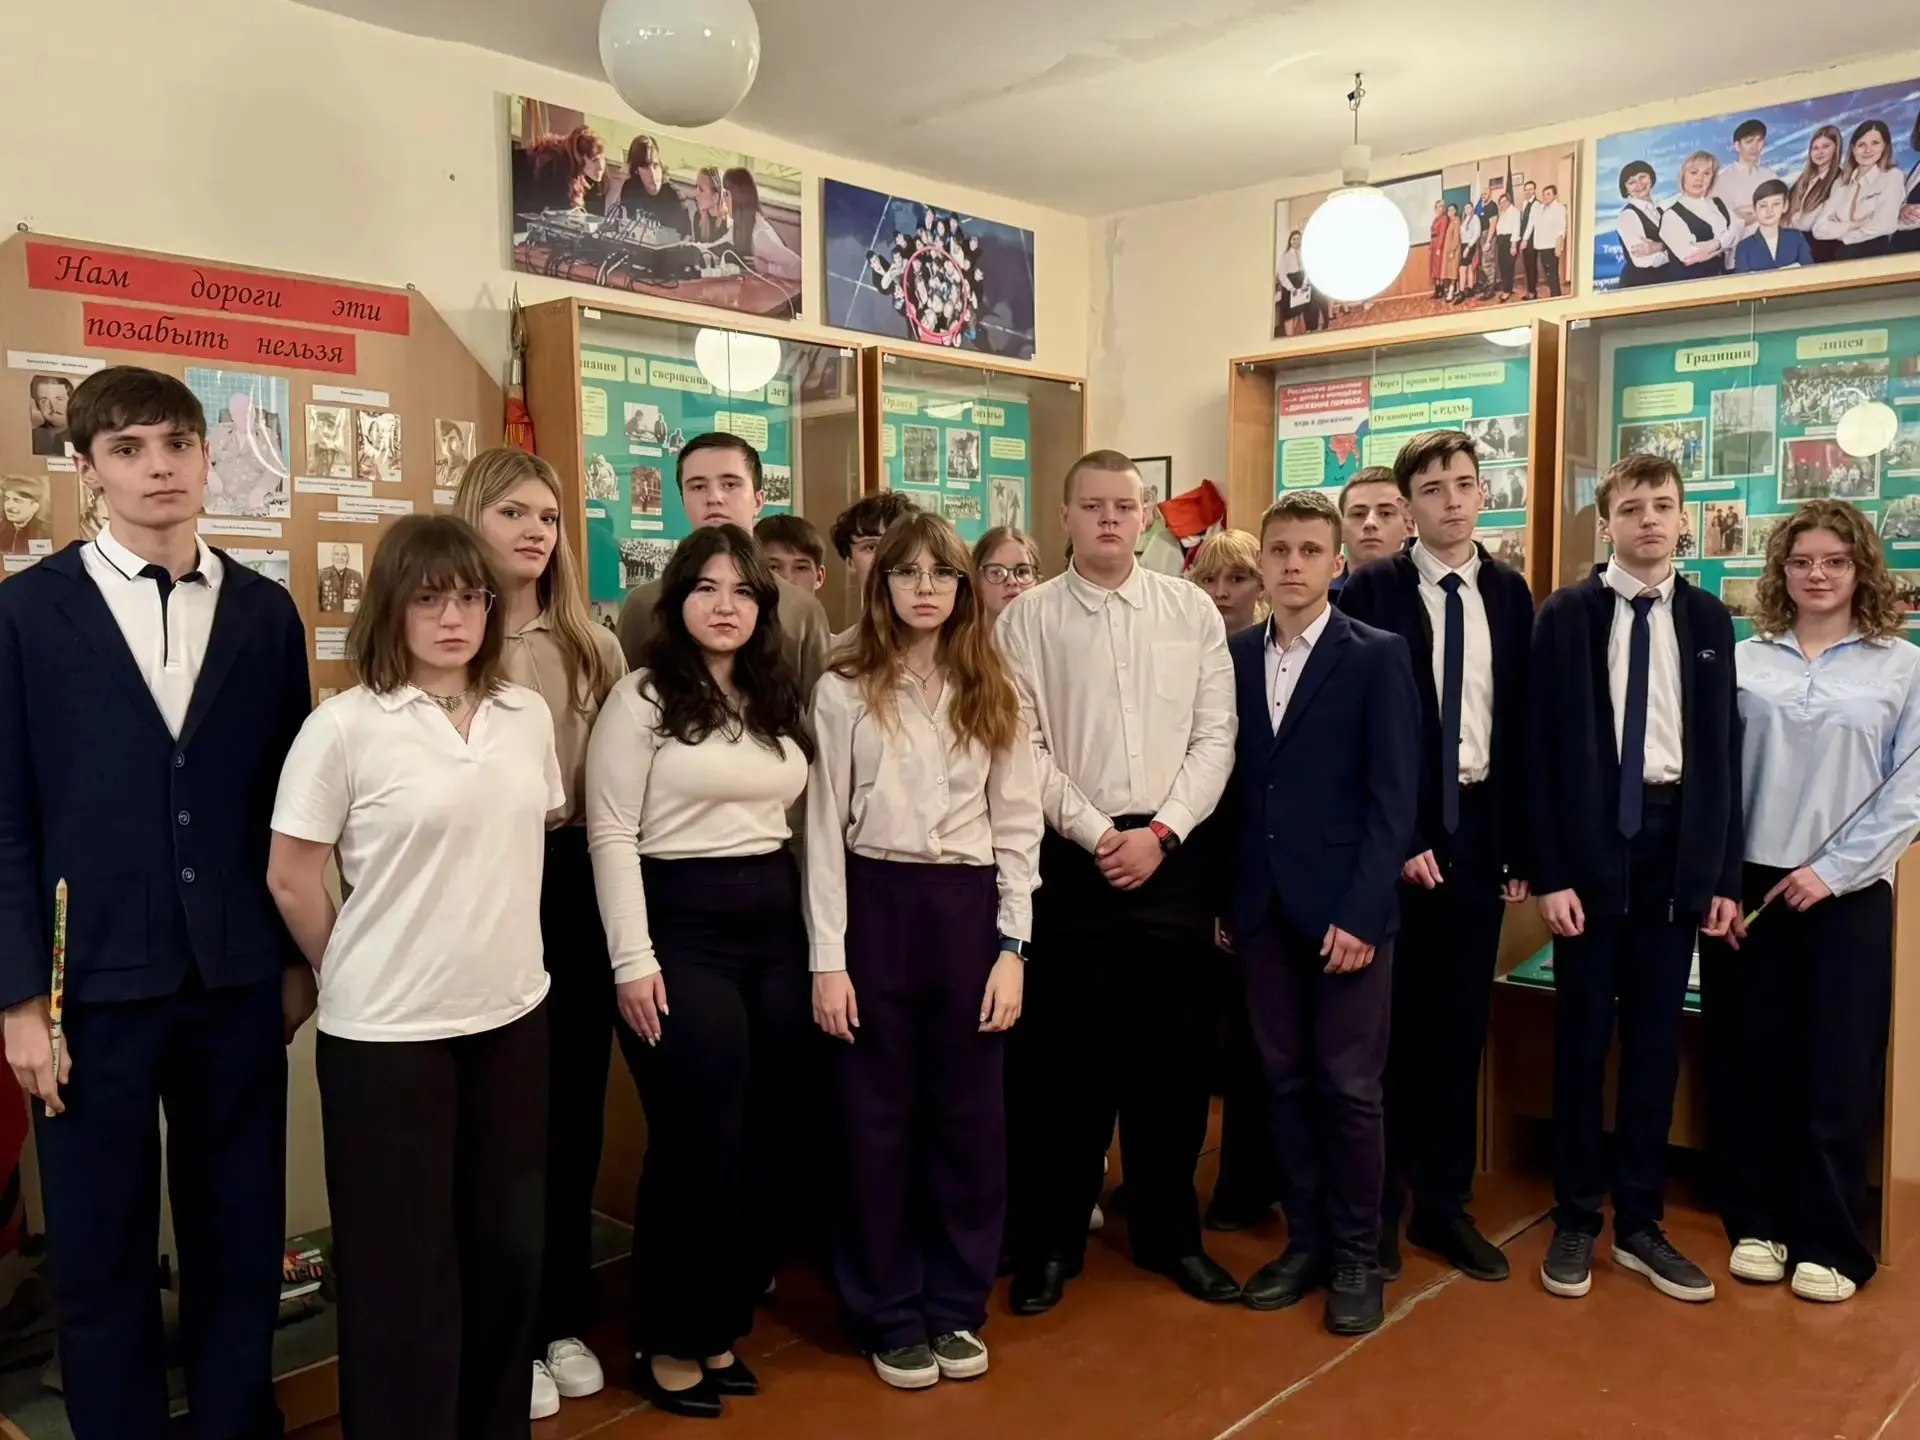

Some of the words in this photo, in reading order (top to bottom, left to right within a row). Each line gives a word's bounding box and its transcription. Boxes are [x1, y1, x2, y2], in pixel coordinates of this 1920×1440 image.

[54, 254, 130, 289] Нам
[190, 269, 282, 312] дороги
[332, 298, 382, 322] эти
[86, 314, 229, 350] позабыть
[256, 336, 345, 364] нельзя
[1818, 337, 1864, 352] лицея
[1683, 349, 1751, 367] Традиции
[652, 369, 709, 385] свершения
[770, 386, 787, 397] лет
